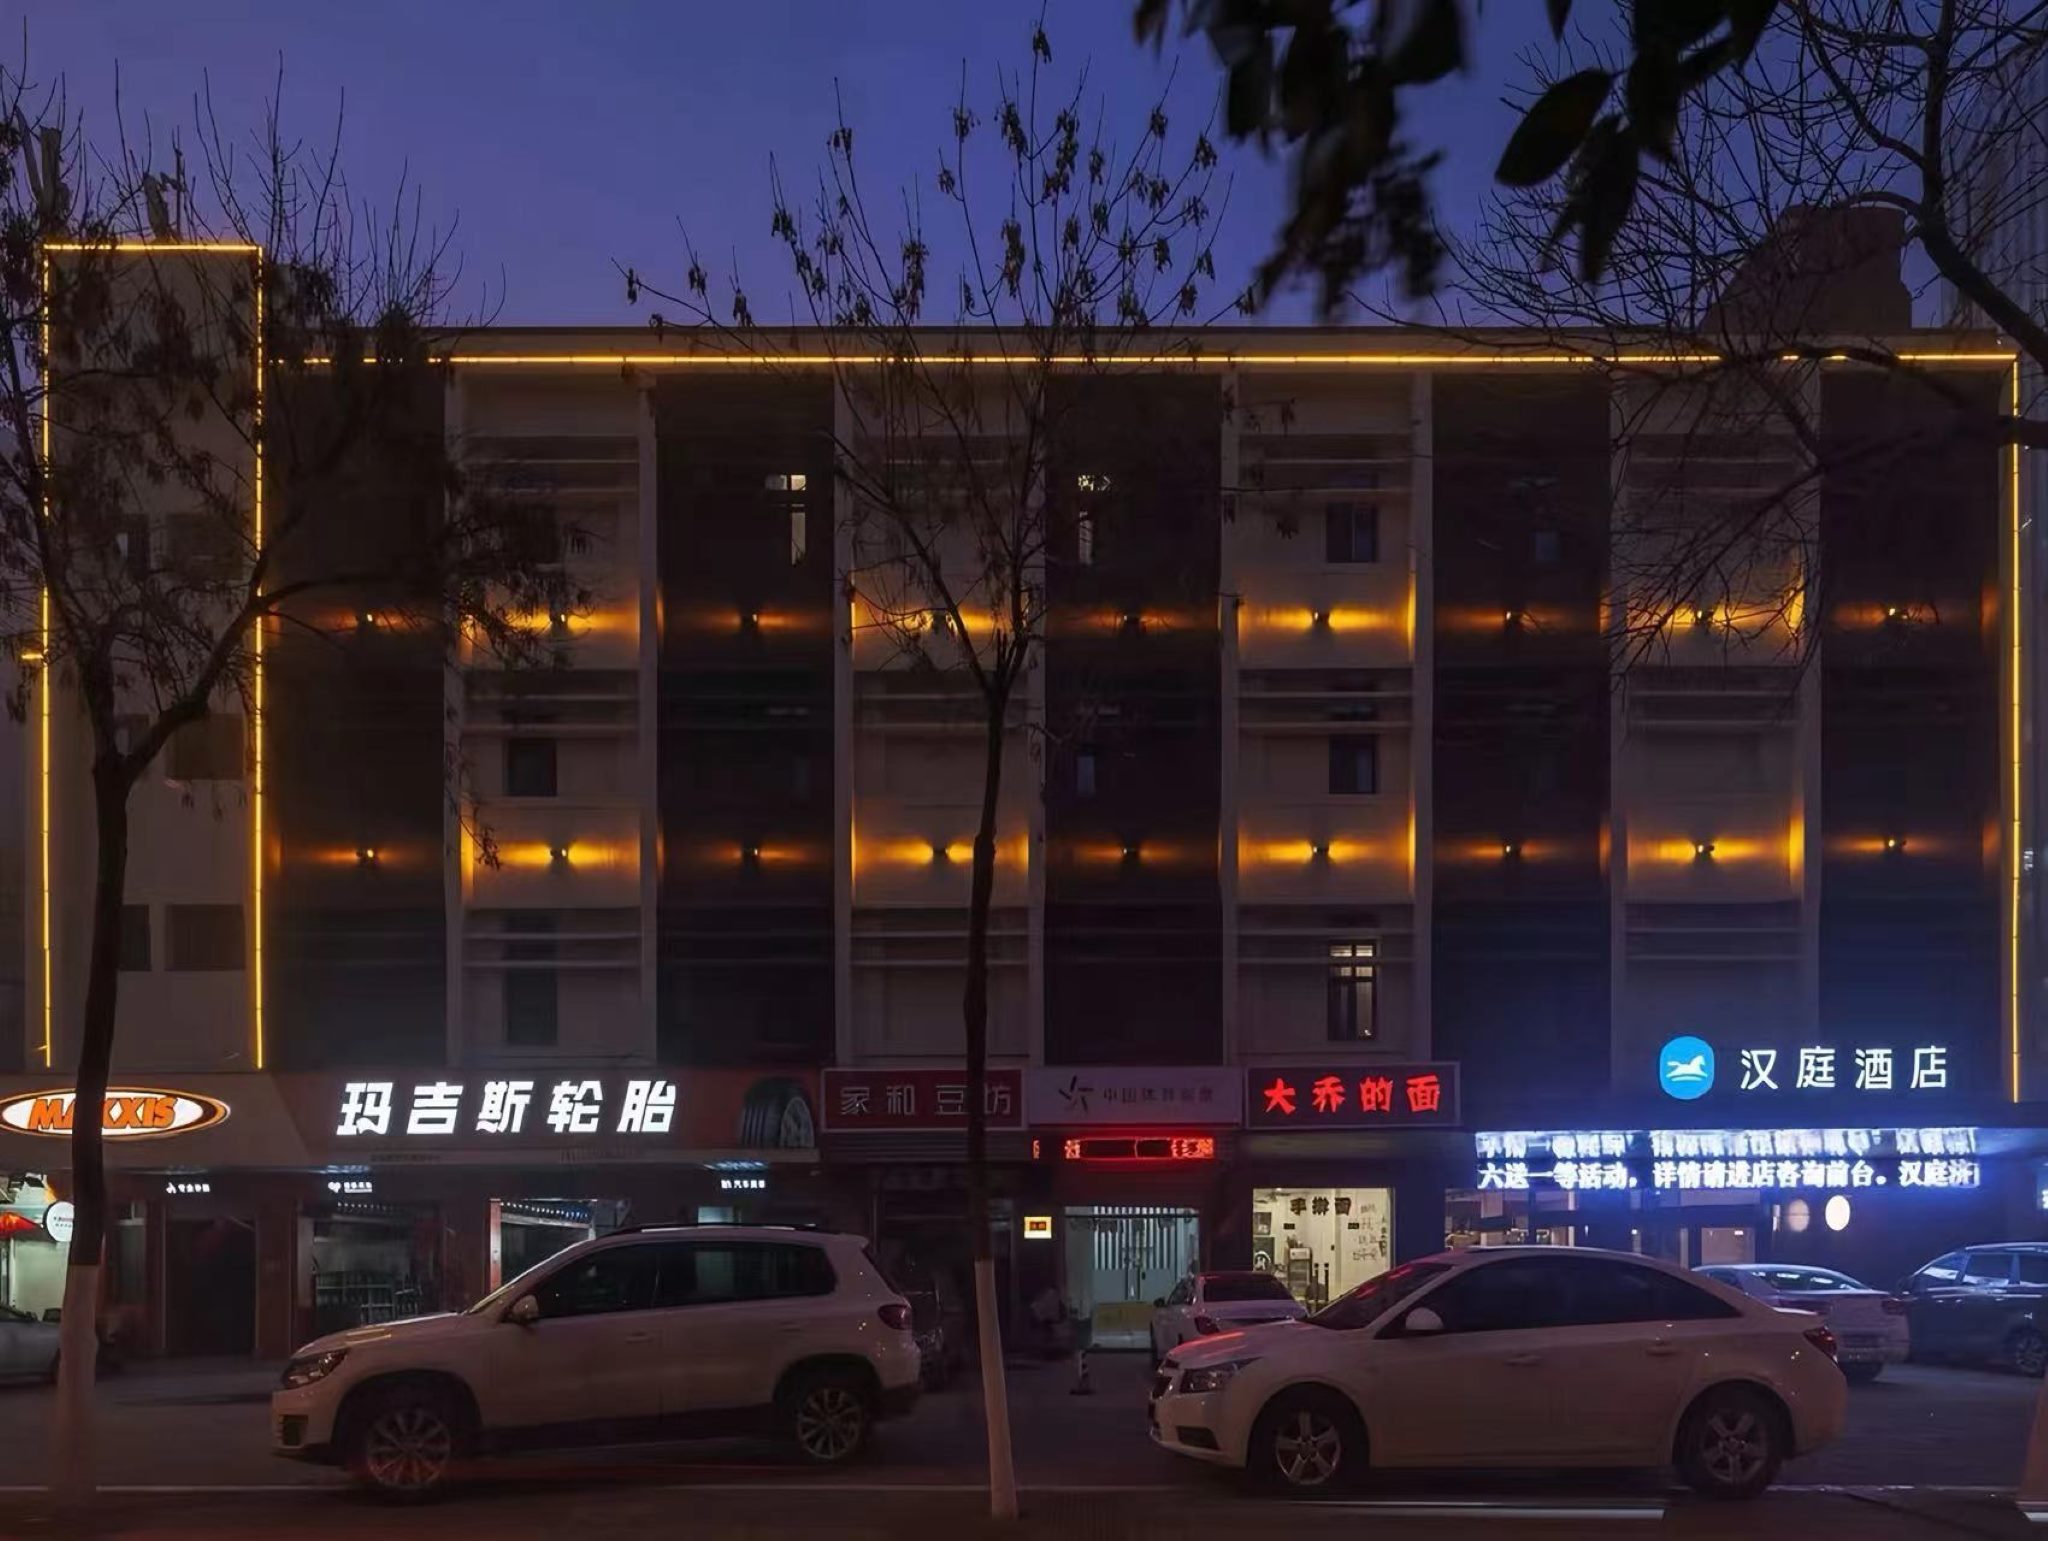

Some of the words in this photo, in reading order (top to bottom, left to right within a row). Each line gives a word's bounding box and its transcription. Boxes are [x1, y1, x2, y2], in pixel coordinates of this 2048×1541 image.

[1740, 1045, 1947, 1090] 汉庭酒店
[336, 1080, 676, 1136] 玛吉斯轮胎
[840, 1083, 1011, 1116] 家和豆坊
[1264, 1075, 1441, 1114] 大乔的面
